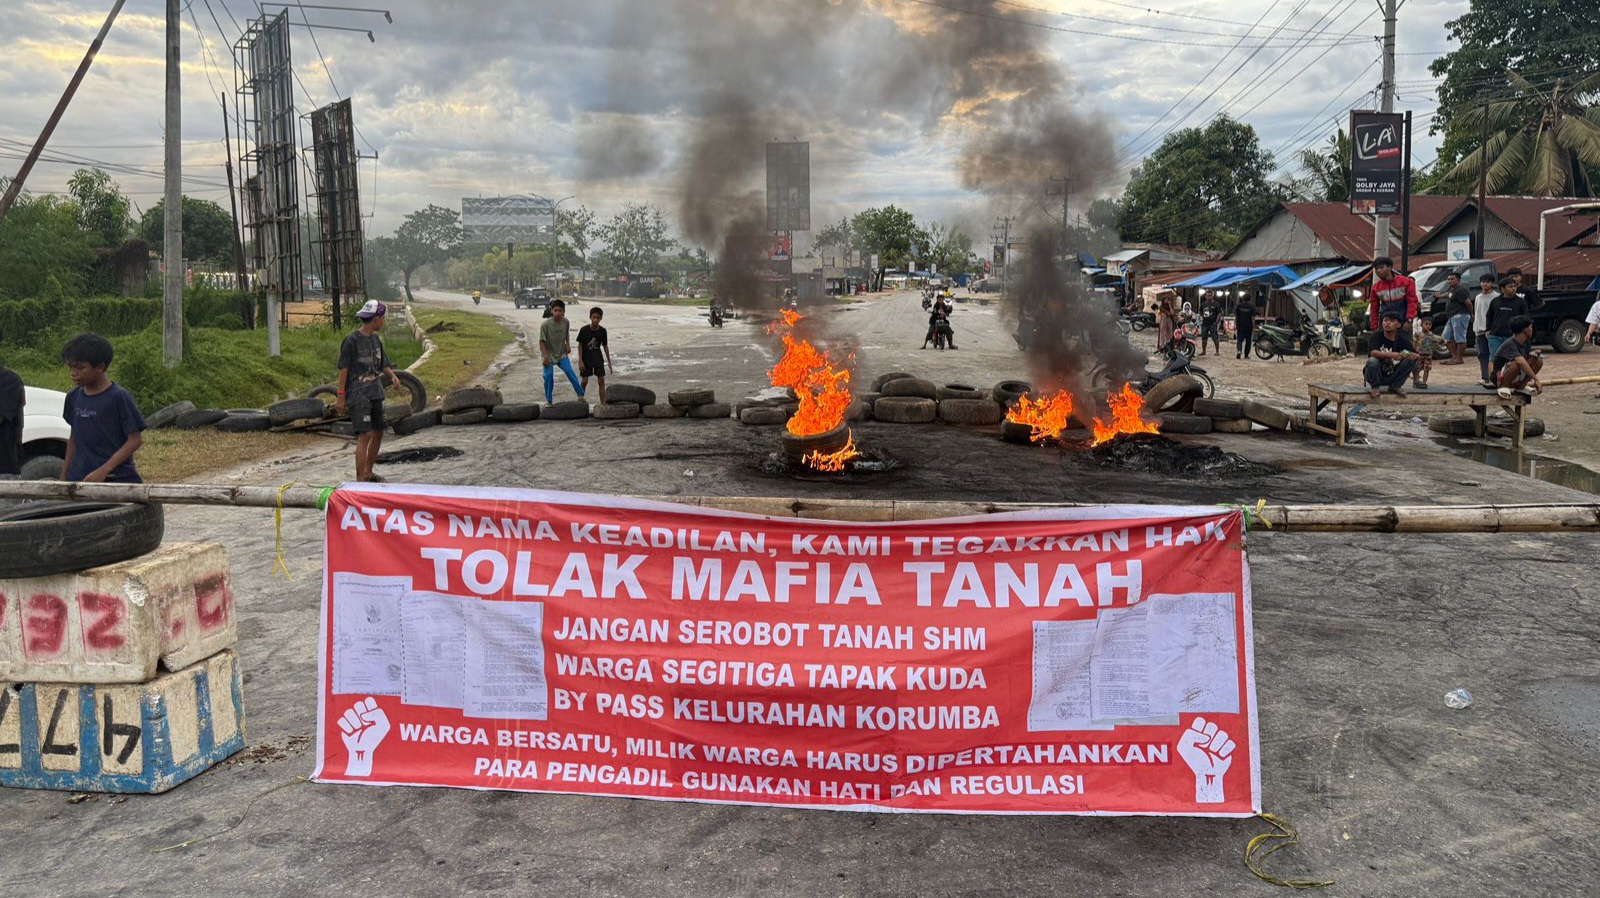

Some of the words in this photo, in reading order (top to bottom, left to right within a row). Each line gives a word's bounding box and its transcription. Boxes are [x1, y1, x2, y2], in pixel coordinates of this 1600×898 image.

[1378, 181, 1395, 189] JAYA
[341, 506, 434, 536] ATAS
[448, 515, 560, 541] NAMA
[570, 522, 777, 557] KEADILAN,
[792, 534, 890, 556] KAMI
[905, 529, 1129, 556] TEGAKKAN
[1146, 521, 1226, 548] HAK
[420, 547, 647, 600] TOLAK
[671, 556, 882, 606] MAFIA
[903, 559, 1142, 608] TANAH
[553, 617, 669, 643] JANGAN
[678, 620, 810, 647] SEROBOT
[818, 624, 913, 650] TANAH
[923, 627, 987, 651] SHM
[555, 653, 654, 683] WARGA
[662, 659, 795, 688] SEGITIGA
[804, 664, 896, 691] TAPAK
[906, 667, 987, 691] KUDA
[553, 688, 587, 711] BY
[596, 693, 664, 720] PASS
[674, 698, 845, 728] KELURAHAN
[856, 706, 1000, 731] KORUMBA
[399, 723, 489, 746] WARGA
[497, 730, 618, 758] BERSATU,
[625, 737, 696, 760] MILIK
[702, 745, 799, 768] WARGA
[806, 750, 898, 773] HARUS
[906, 743, 1169, 774] DIPERTAHANKAN
[474, 758, 538, 780] PARA
[546, 762, 674, 788] PENGADIL
[682, 771, 812, 797] GUNAKAN
[820, 781, 881, 801] HATI
[890, 776, 942, 799] DAN
[950, 774, 1084, 795] REGULASI
